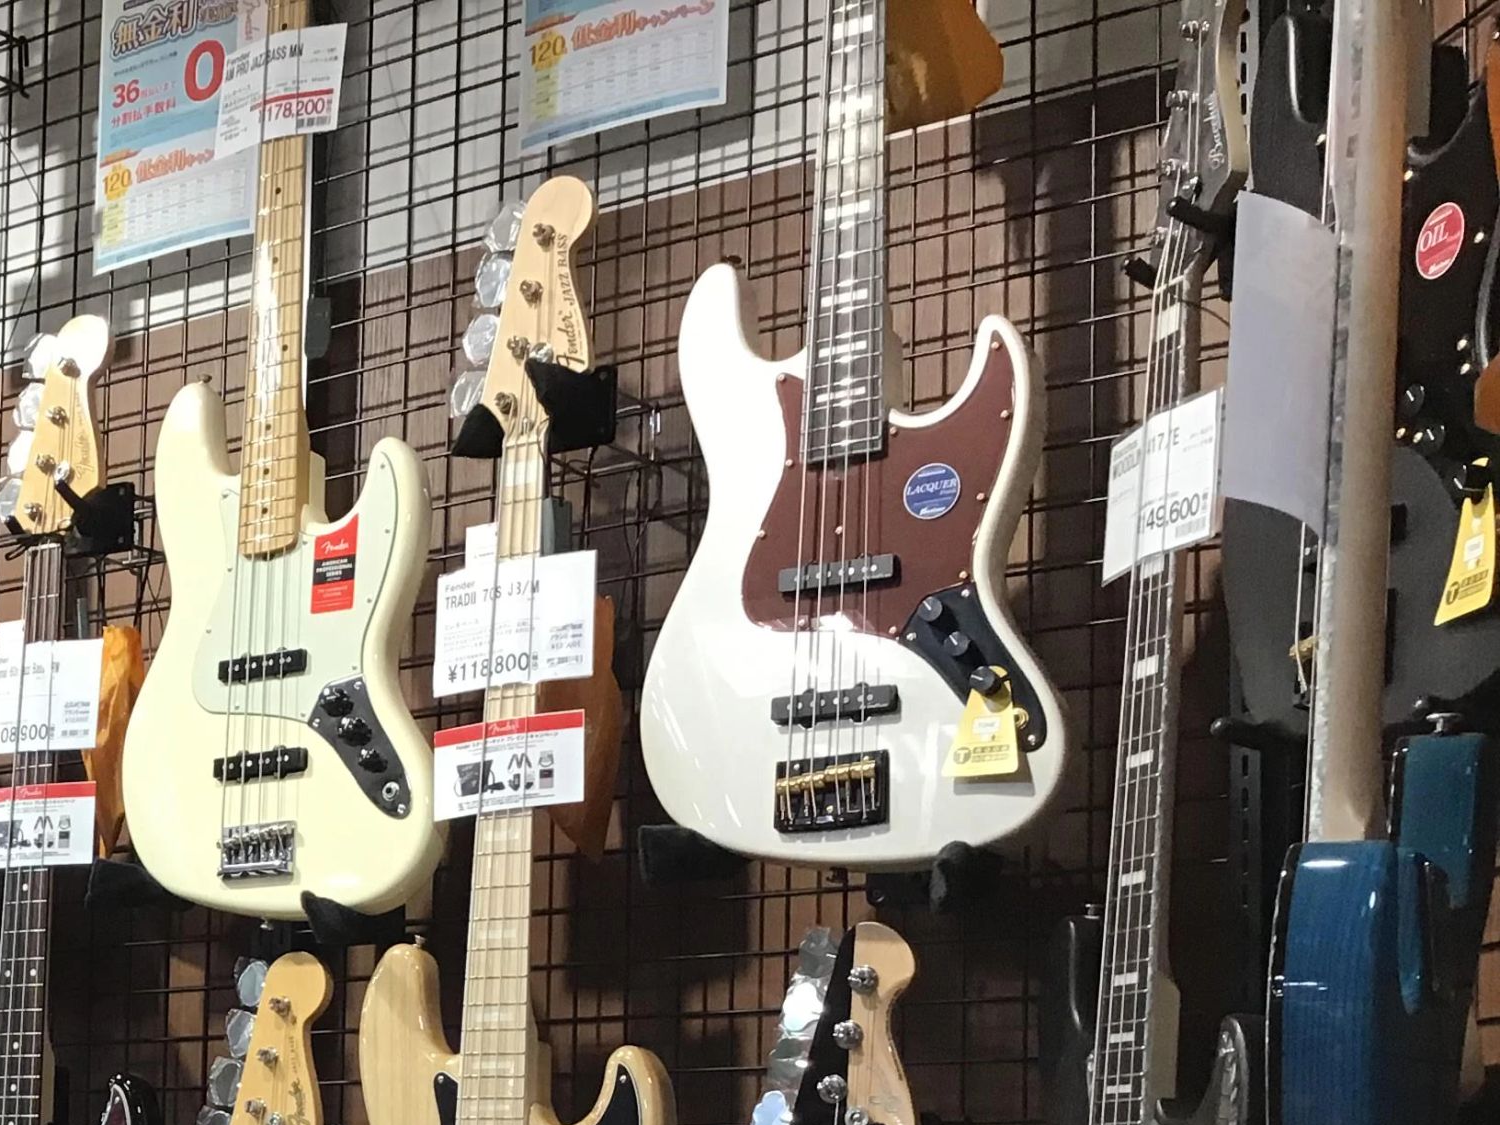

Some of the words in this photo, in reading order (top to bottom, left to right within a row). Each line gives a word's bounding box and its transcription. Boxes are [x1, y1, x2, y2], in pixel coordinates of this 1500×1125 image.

[184, 40, 226, 102] 0
[112, 80, 140, 109] 36
[557, 233, 569, 268] BASS
[1420, 221, 1449, 252] OIL
[563, 272, 576, 305] JAZZ
[906, 478, 956, 496] LACQUER
[445, 580, 476, 593] Fender
